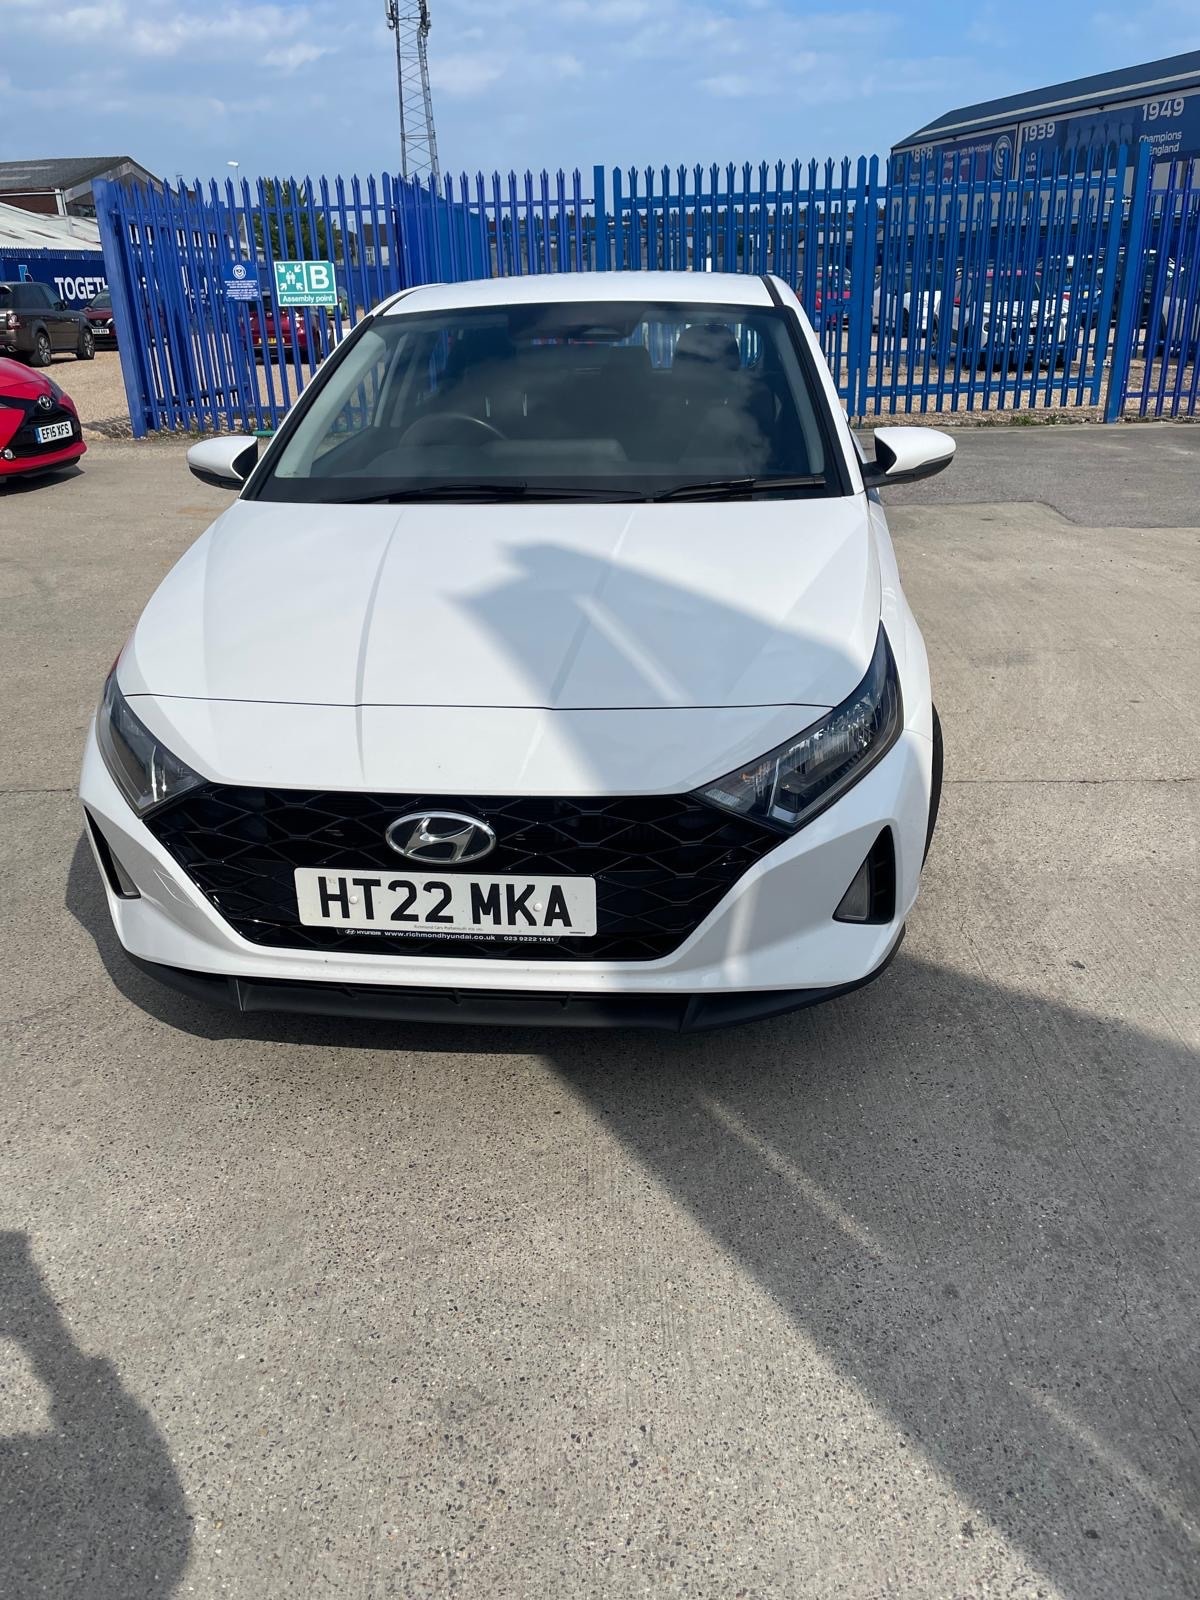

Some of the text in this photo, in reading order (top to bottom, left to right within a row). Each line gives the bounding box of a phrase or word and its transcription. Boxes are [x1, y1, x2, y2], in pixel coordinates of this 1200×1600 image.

[1142, 98, 1185, 121] 1949
[1024, 122, 1056, 142] 1939
[309, 265, 330, 289] B
[282, 295, 333, 303] Assembly point
[41, 423, 70, 440] EF15 XFS
[317, 876, 573, 928] HT22 MKA
[384, 930, 496, 941] www.richmondhyundai.co.uk
